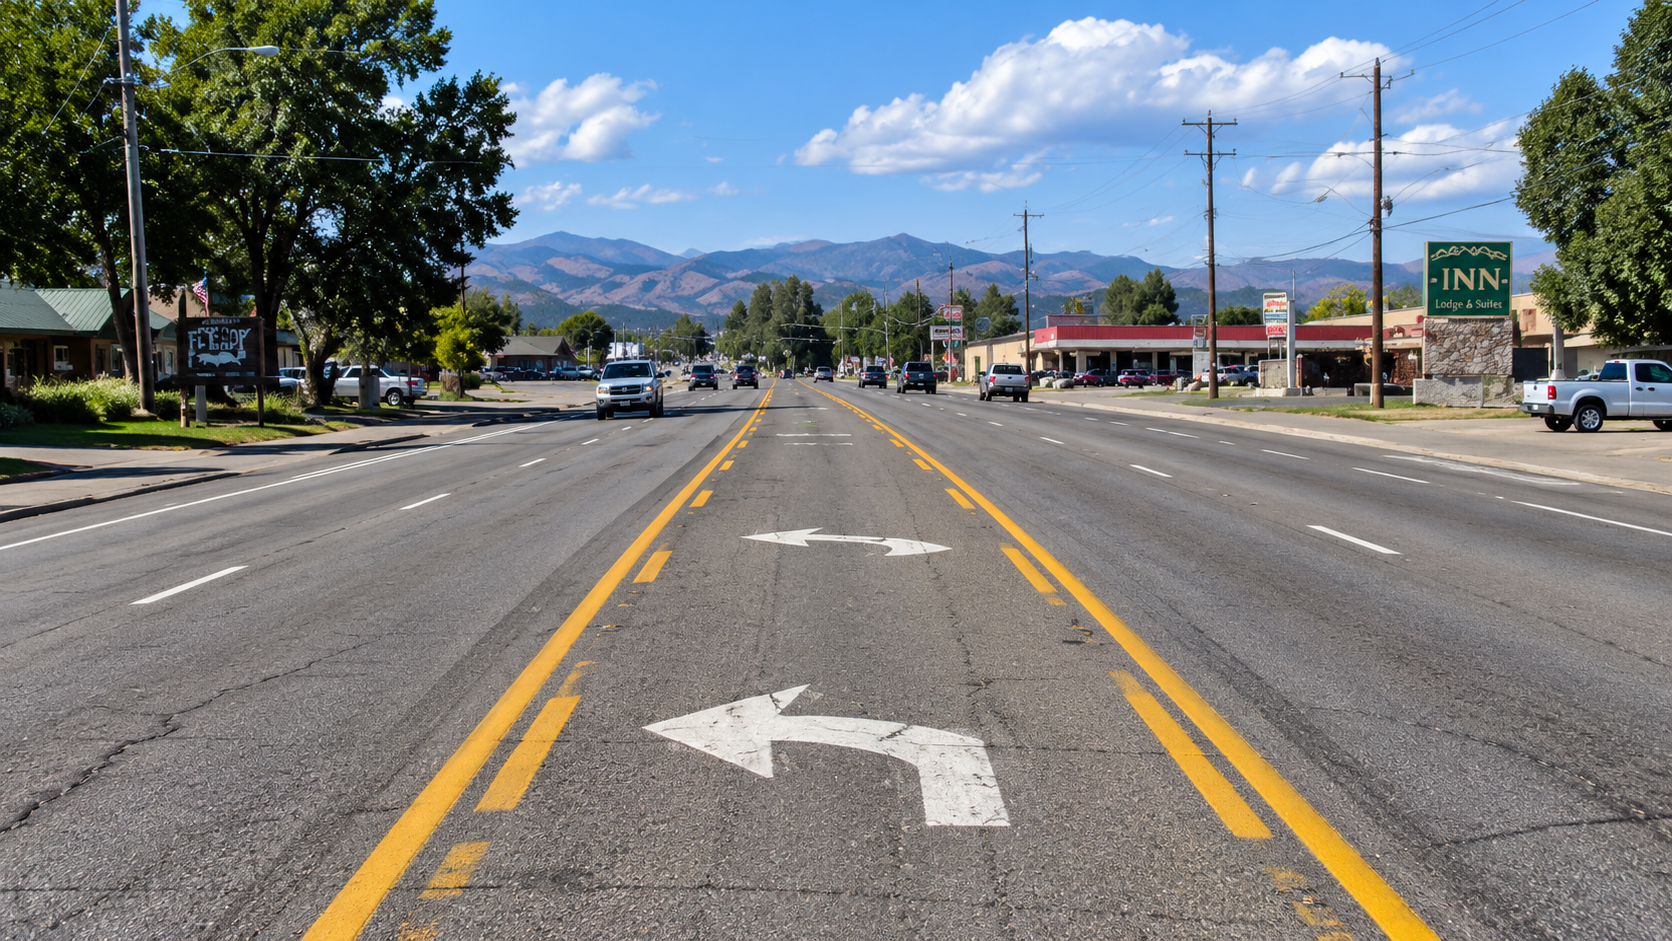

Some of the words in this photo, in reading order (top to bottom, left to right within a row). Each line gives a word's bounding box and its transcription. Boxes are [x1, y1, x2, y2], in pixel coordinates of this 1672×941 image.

[1442, 268, 1501, 290] INN
[1435, 299, 1463, 312] Lodge
[1466, 299, 1473, 309] &
[1475, 299, 1502, 309] Suites
